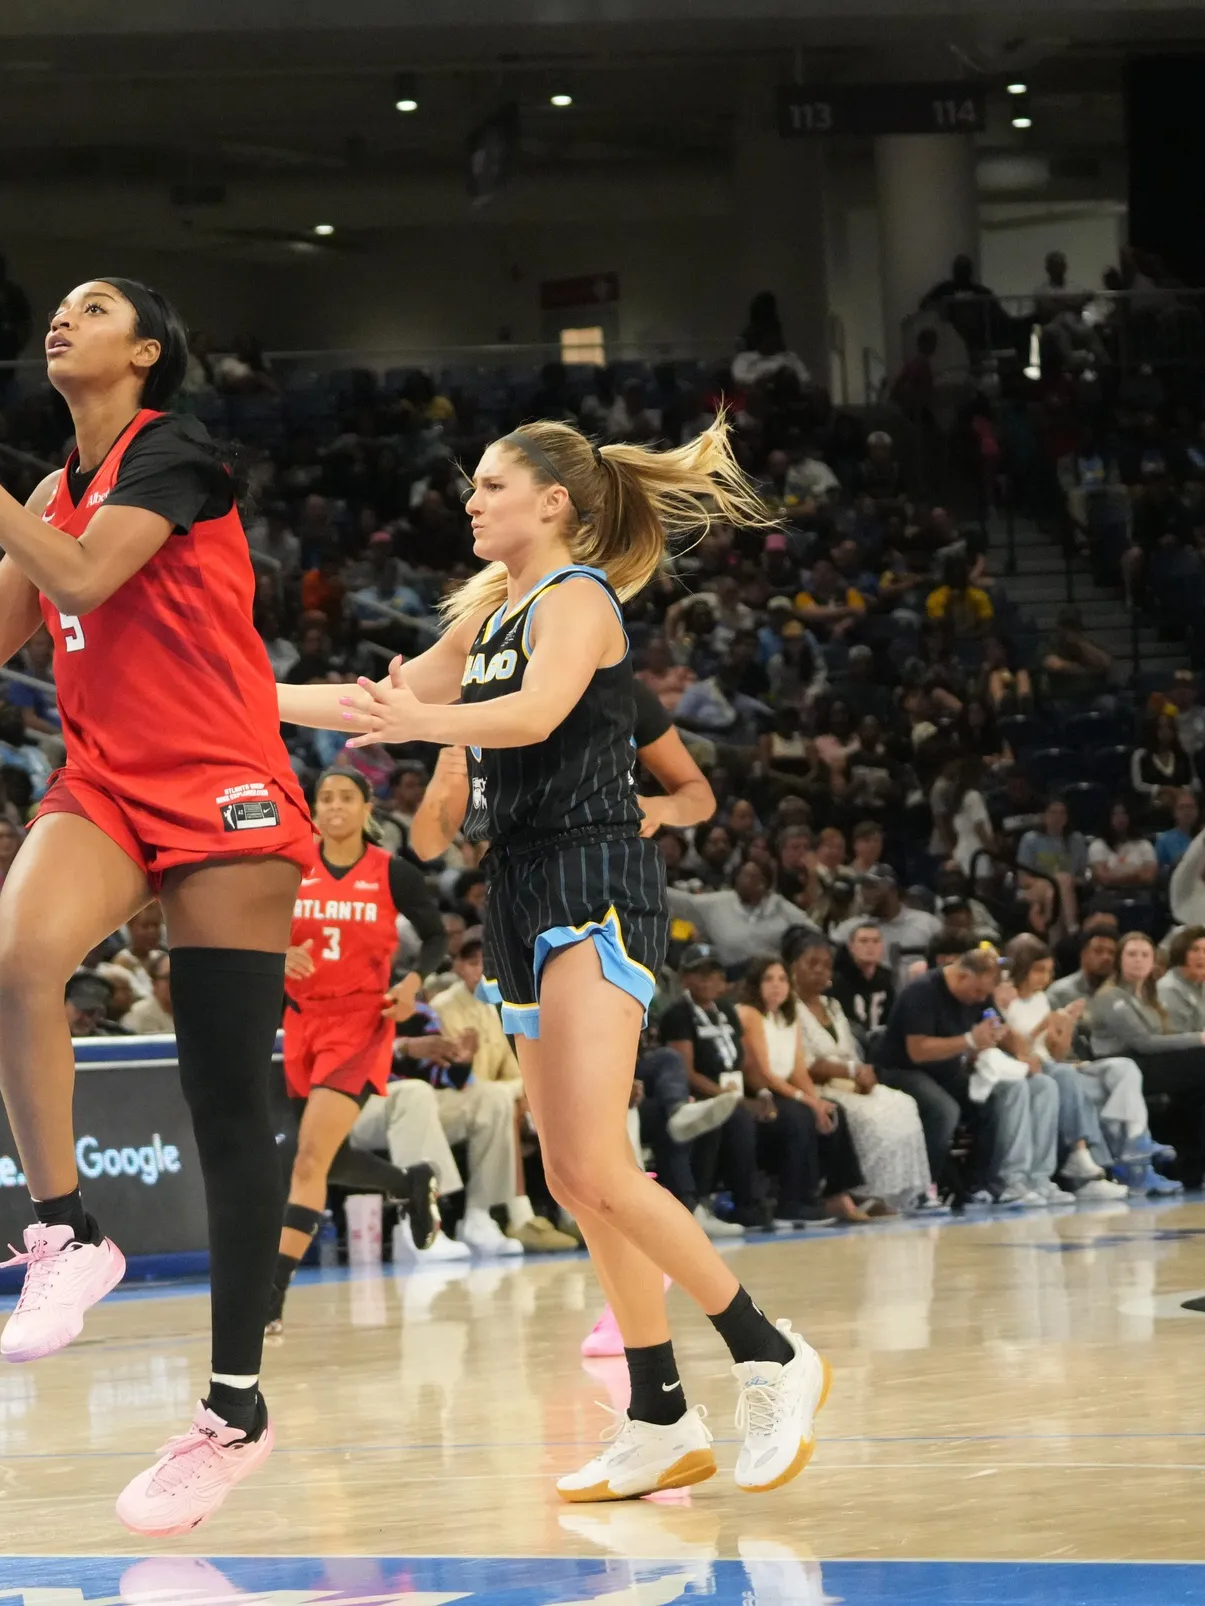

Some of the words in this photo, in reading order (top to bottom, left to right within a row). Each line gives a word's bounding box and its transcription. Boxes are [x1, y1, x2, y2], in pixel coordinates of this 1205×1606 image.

[789, 102, 832, 130] 113
[932, 100, 976, 124] 114
[293, 898, 378, 923] ATLANTA
[321, 925, 342, 961] 3
[75, 1132, 181, 1185] Google
